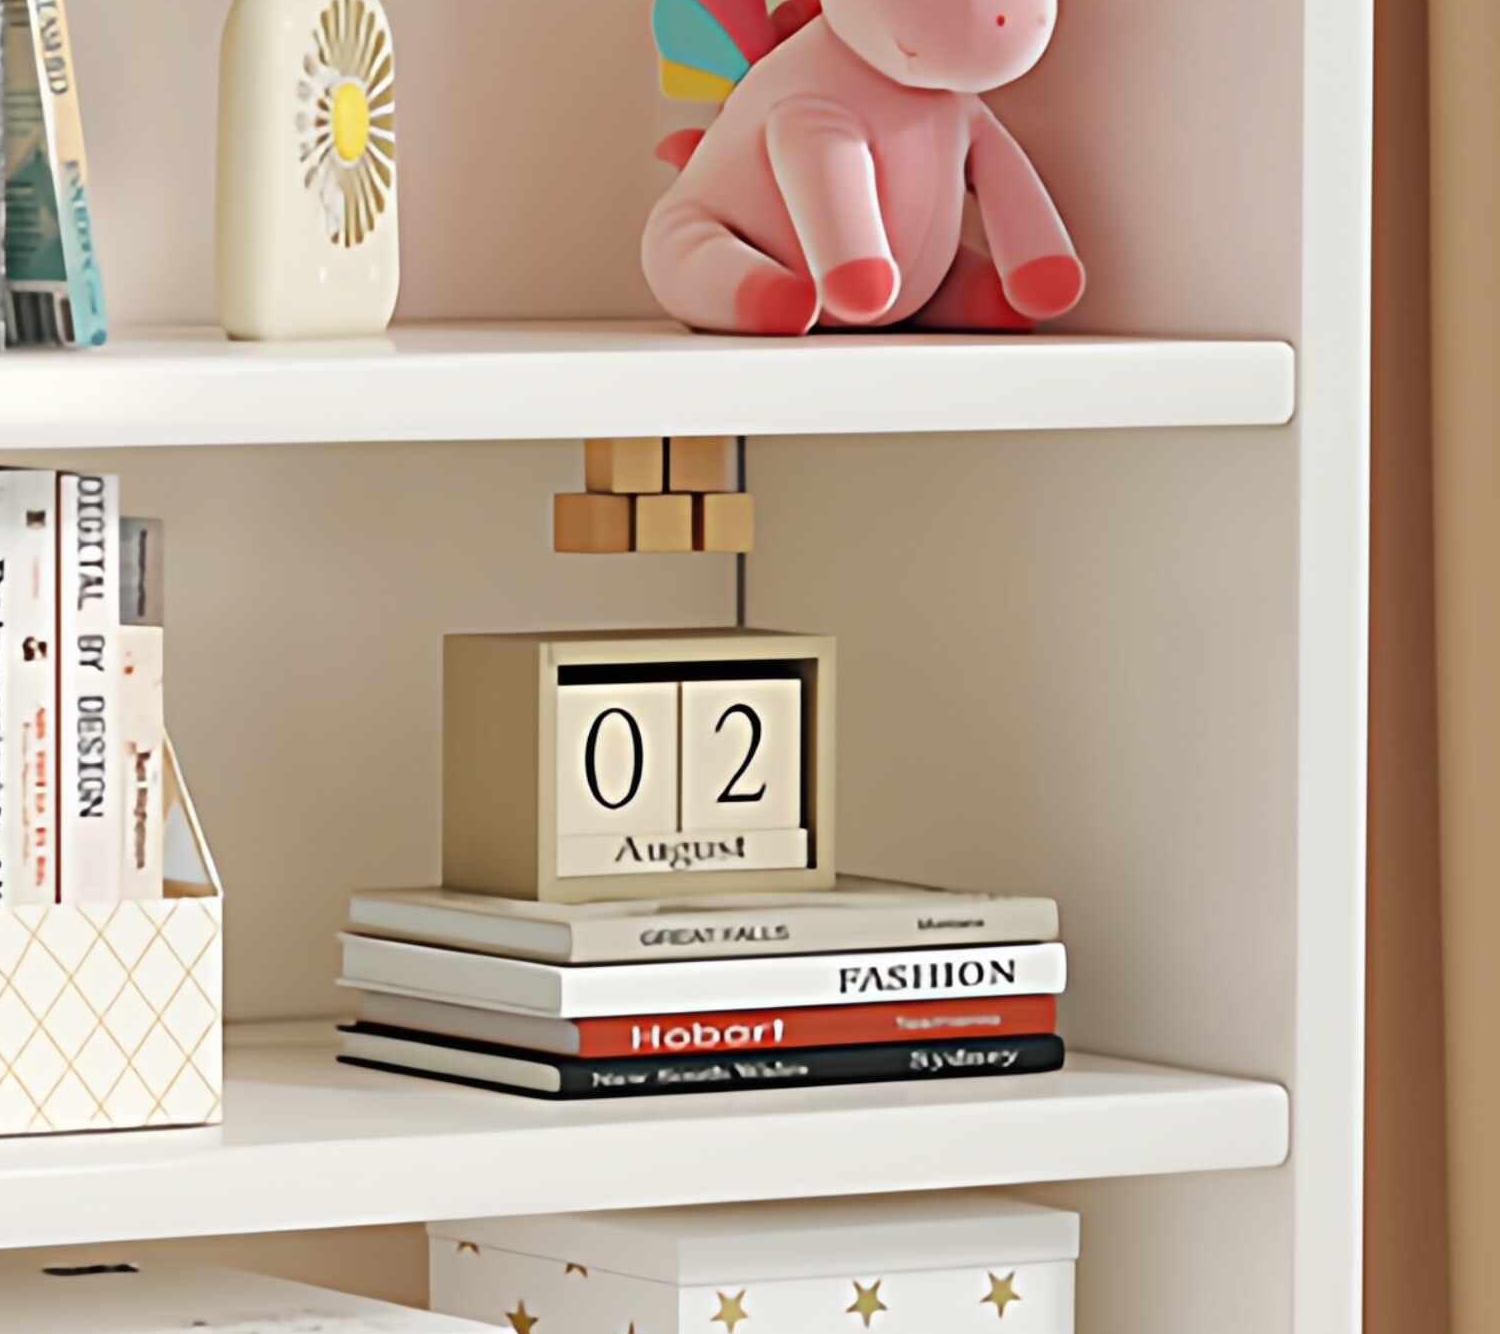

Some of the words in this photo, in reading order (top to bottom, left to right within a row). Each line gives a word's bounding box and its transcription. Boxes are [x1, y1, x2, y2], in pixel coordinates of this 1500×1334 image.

[76, 475, 106, 611] DIGITAL
[76, 634, 106, 672] BY
[76, 695, 106, 818] DESIGN
[614, 835, 746, 871] August
[838, 958, 1016, 995] FASHION
[630, 1017, 785, 1052] Hobart
[909, 1048, 1020, 1073] Sydney
